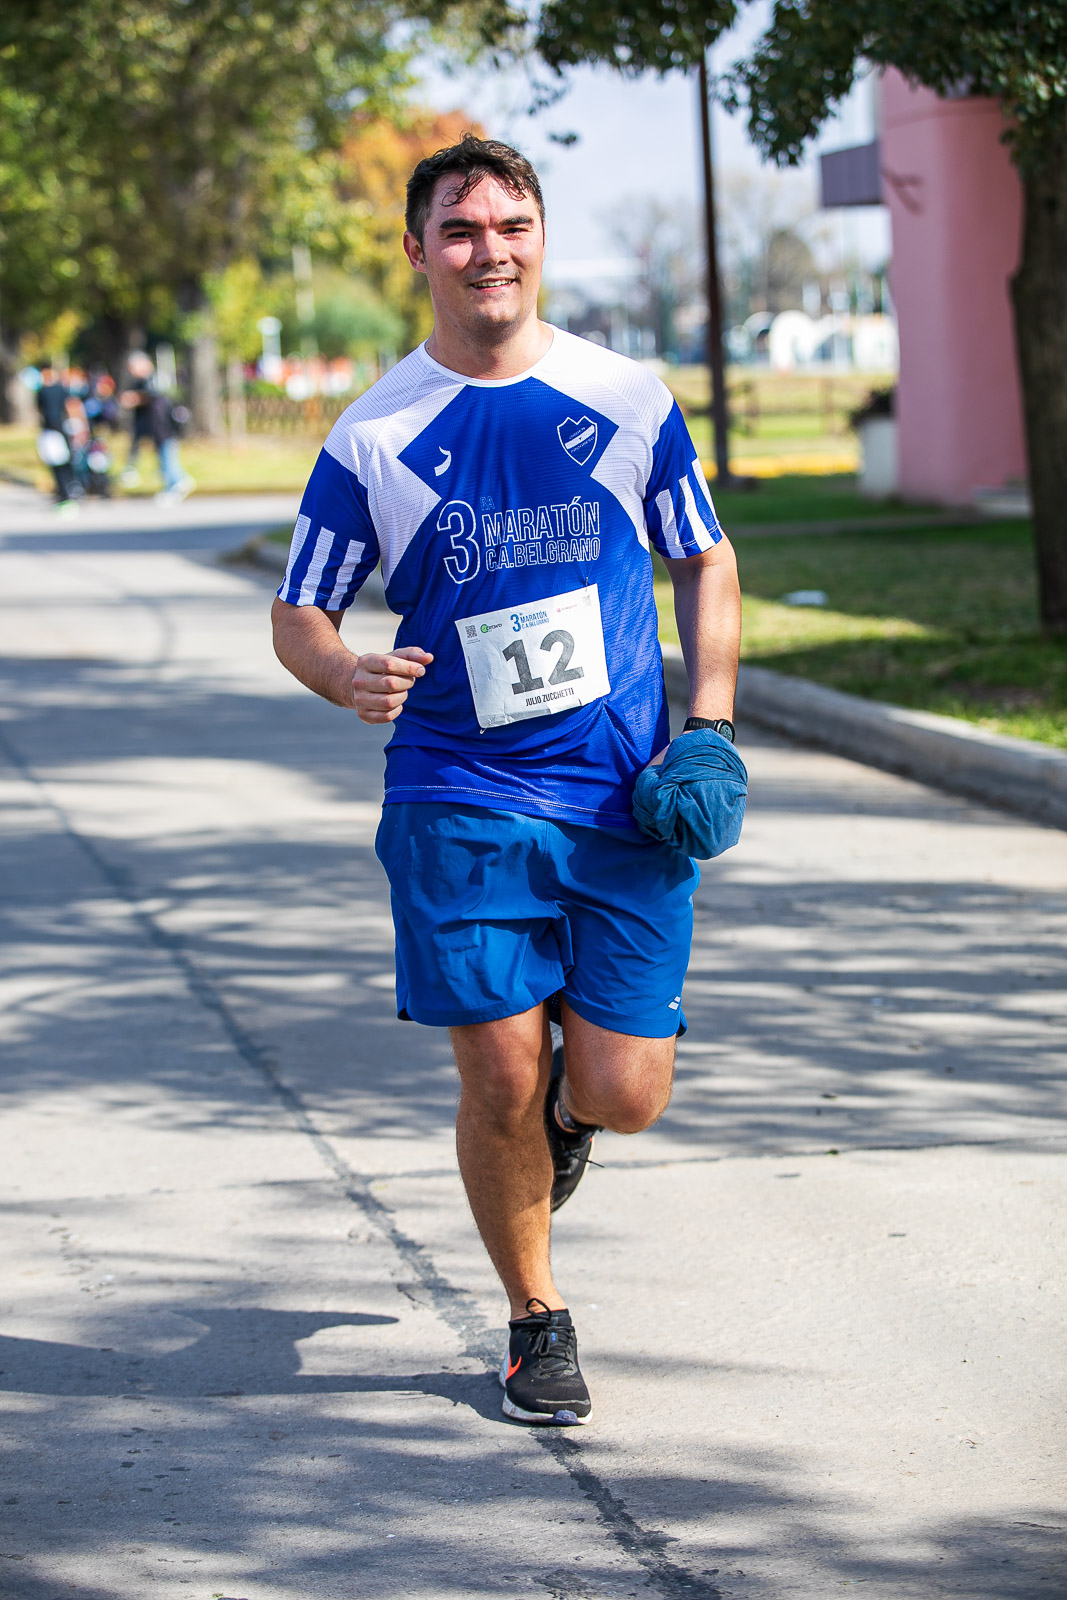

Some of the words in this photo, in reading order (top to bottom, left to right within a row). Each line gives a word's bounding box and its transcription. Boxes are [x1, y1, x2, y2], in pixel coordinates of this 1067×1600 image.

[481, 496, 600, 547] MARATÓN
[436, 500, 481, 584] 3
[510, 613, 522, 632] 3
[520, 611, 548, 624] MARATÓN
[502, 629, 585, 695] 12
[525, 695, 542, 707] JULIO
[542, 687, 575, 703] ZUCCHETTI
